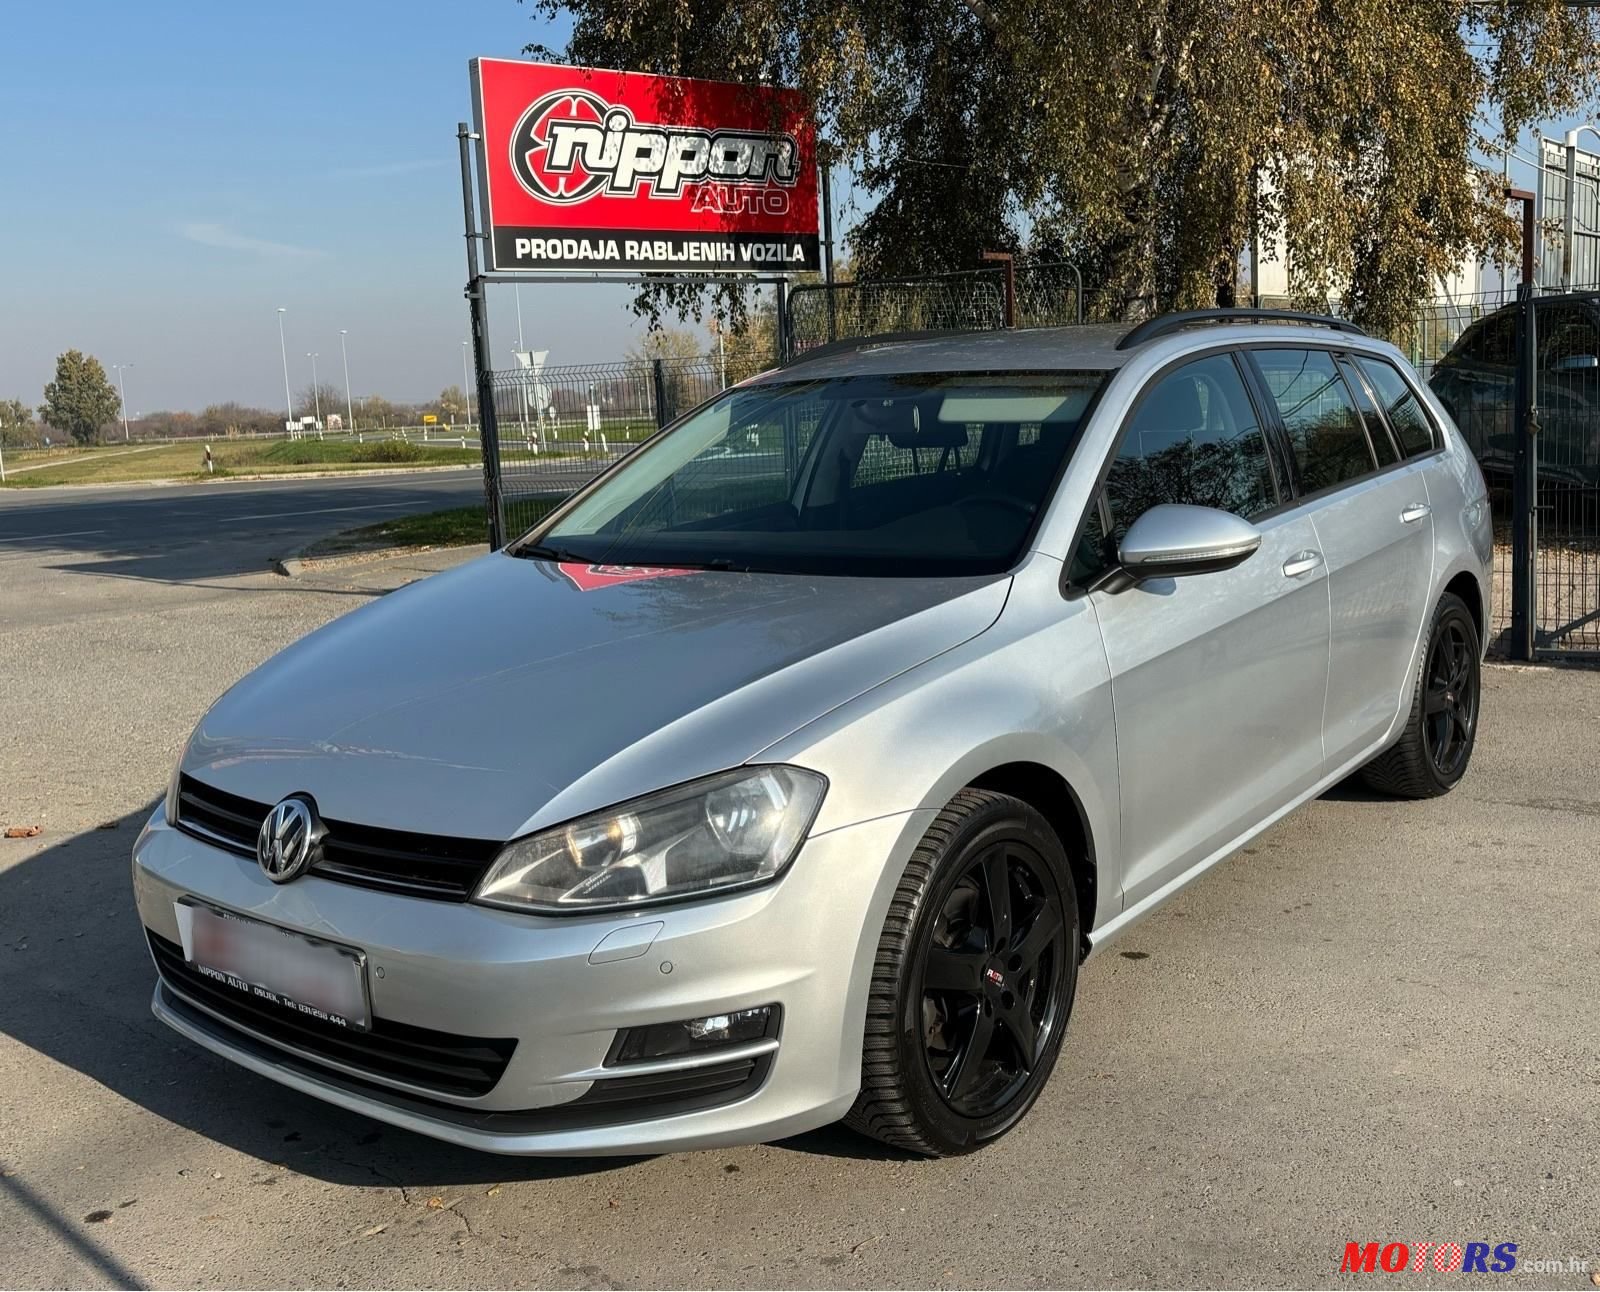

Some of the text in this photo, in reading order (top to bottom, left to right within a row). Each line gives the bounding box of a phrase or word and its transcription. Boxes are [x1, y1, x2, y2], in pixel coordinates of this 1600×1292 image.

[545, 109, 797, 192] nippon
[691, 185, 790, 214] AUTO
[515, 238, 805, 262] PRODAJA RABLJENIH VOZILA
[198, 964, 225, 983] NIPPON
[228, 977, 249, 992] AUTO
[330, 1015, 346, 1027] 444
